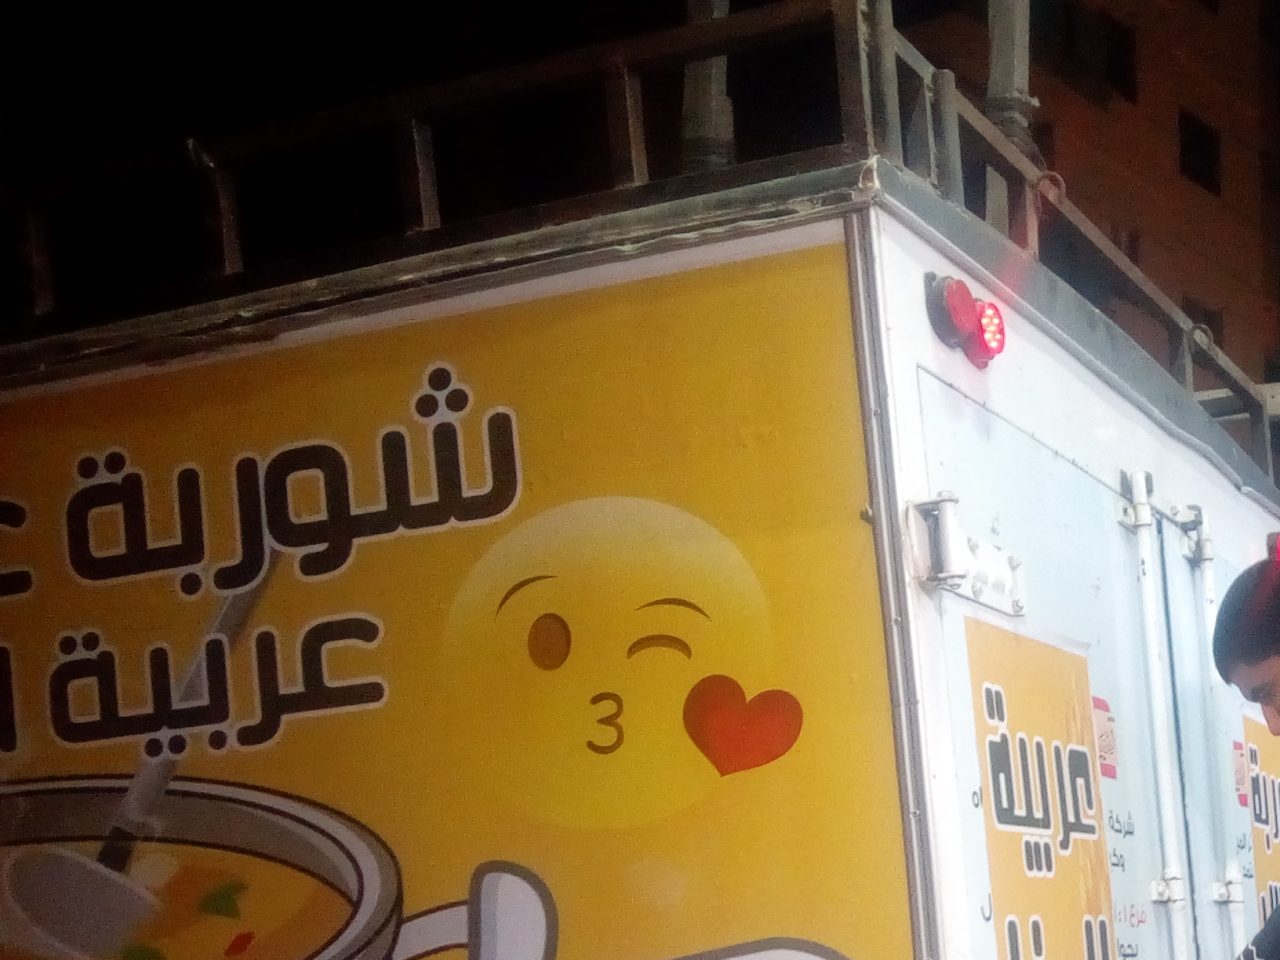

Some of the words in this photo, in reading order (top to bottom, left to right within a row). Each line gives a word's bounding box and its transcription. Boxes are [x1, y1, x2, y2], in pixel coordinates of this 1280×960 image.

[66, 363, 519, 597] شوربة
[47, 615, 388, 758] عربية
[982, 682, 1099, 877] عربية
